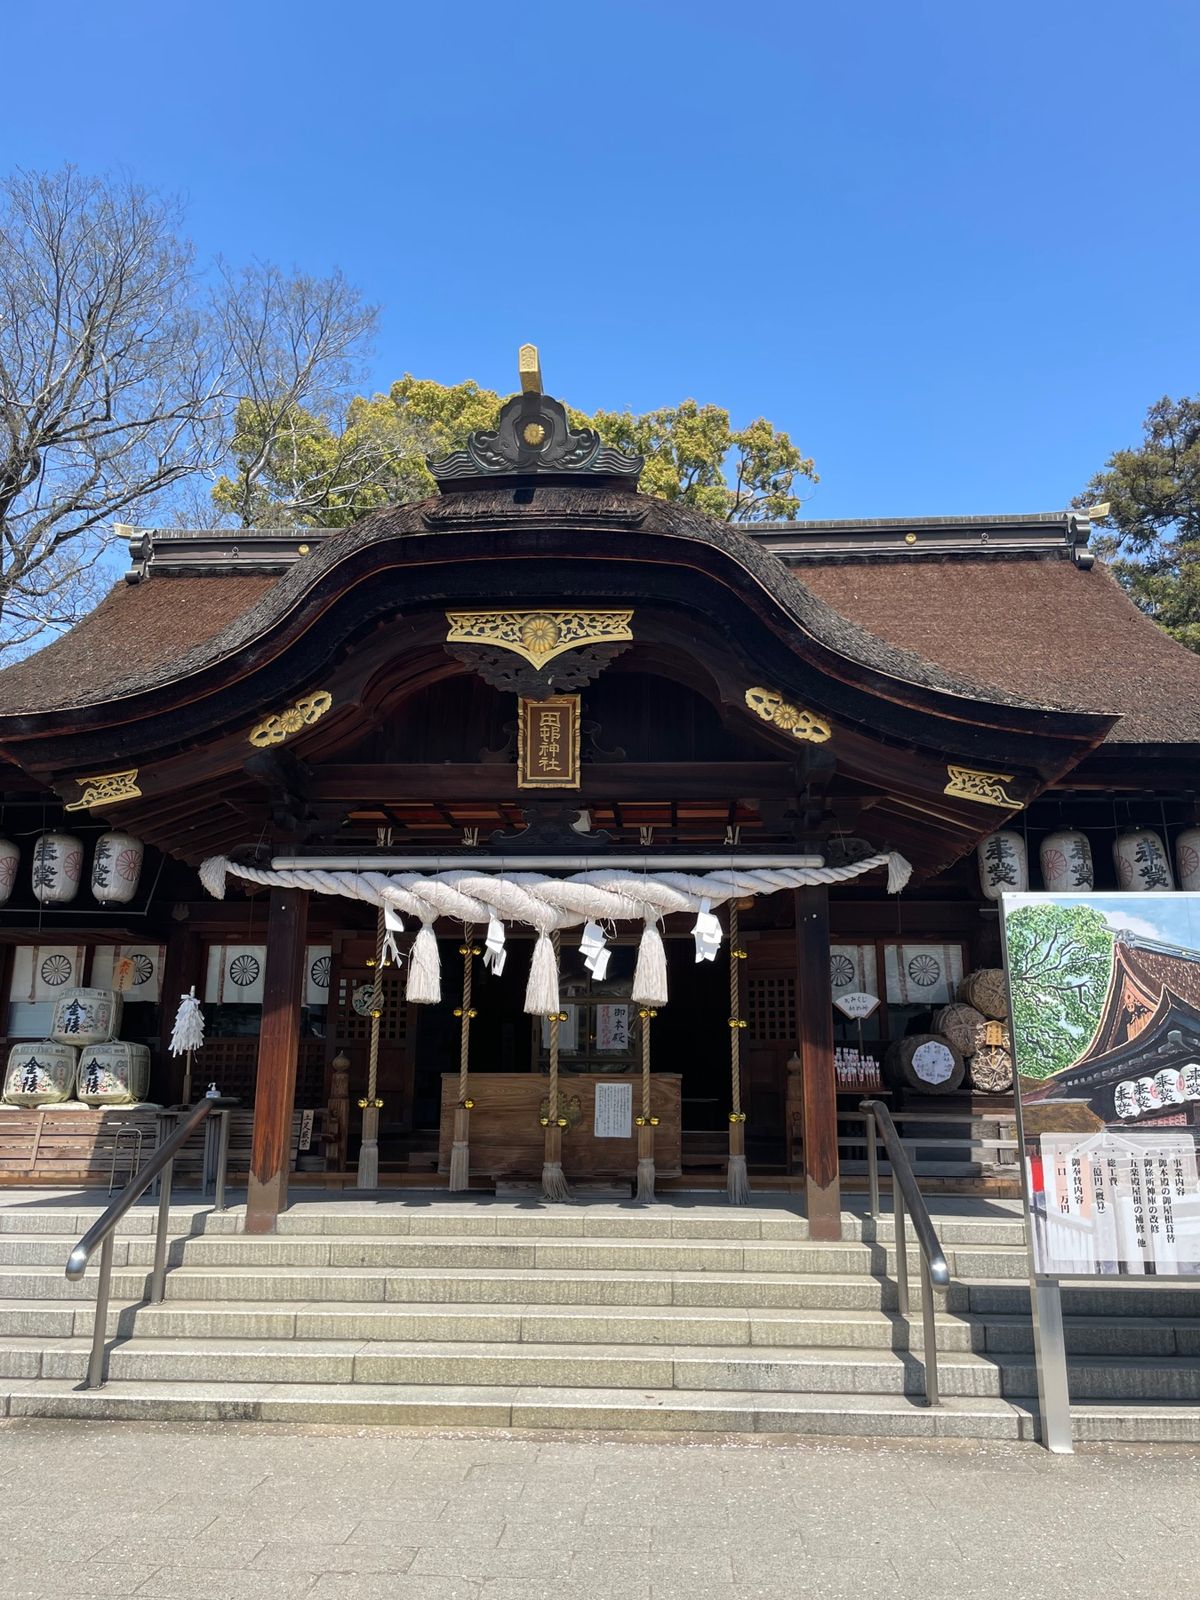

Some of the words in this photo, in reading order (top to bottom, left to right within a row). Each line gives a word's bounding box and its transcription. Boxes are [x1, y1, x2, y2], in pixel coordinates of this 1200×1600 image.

[66, 998, 87, 1034] 金陵
[612, 1008, 626, 1043] 御本殿
[22, 1056, 45, 1094] 金陵
[85, 1057, 105, 1095] 金陵
